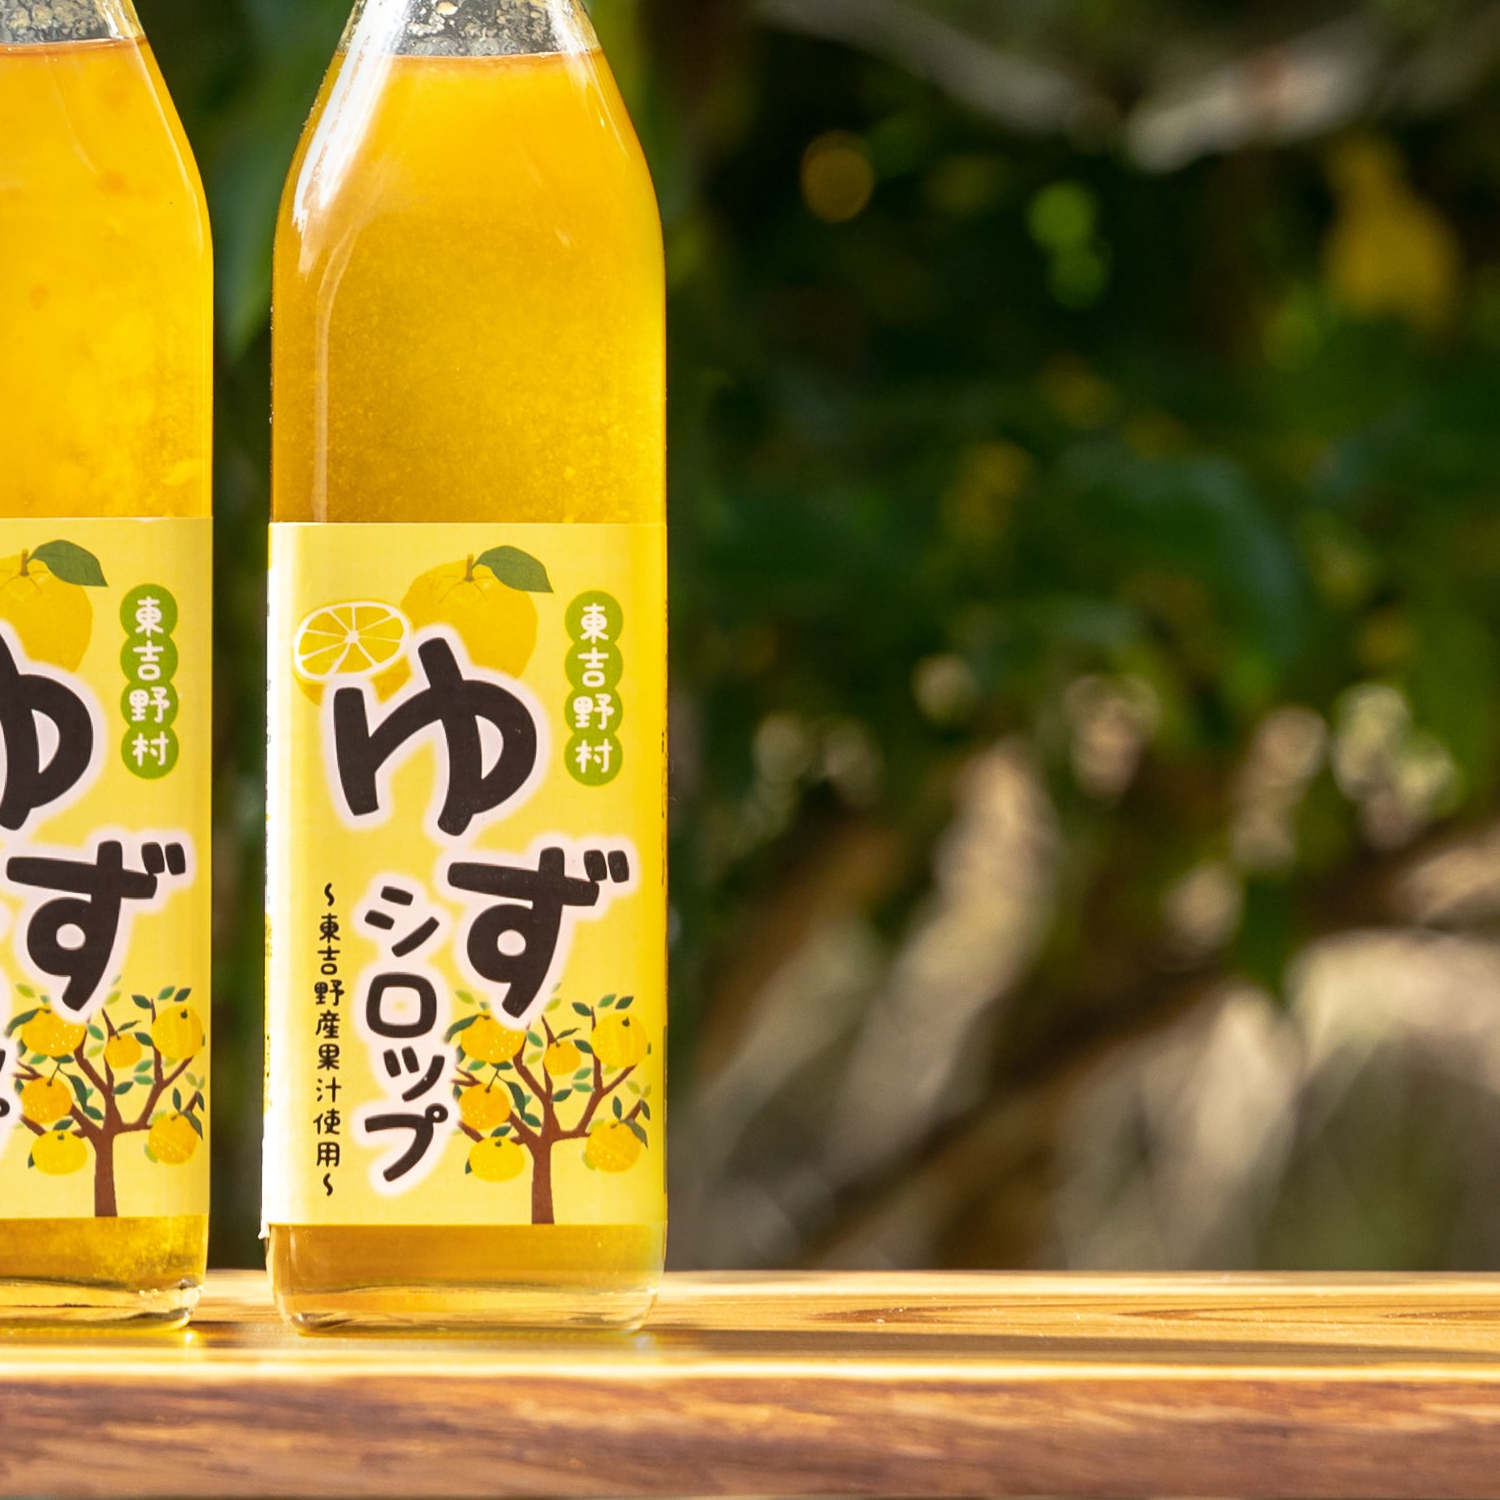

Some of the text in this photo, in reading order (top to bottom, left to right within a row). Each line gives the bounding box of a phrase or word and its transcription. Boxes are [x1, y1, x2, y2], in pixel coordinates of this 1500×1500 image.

[129, 596, 170, 766] 東吉野村
[573, 603, 614, 773] 東吉野村
[334, 637, 630, 1018] ゆず
[364, 885, 449, 1182] シロップ
